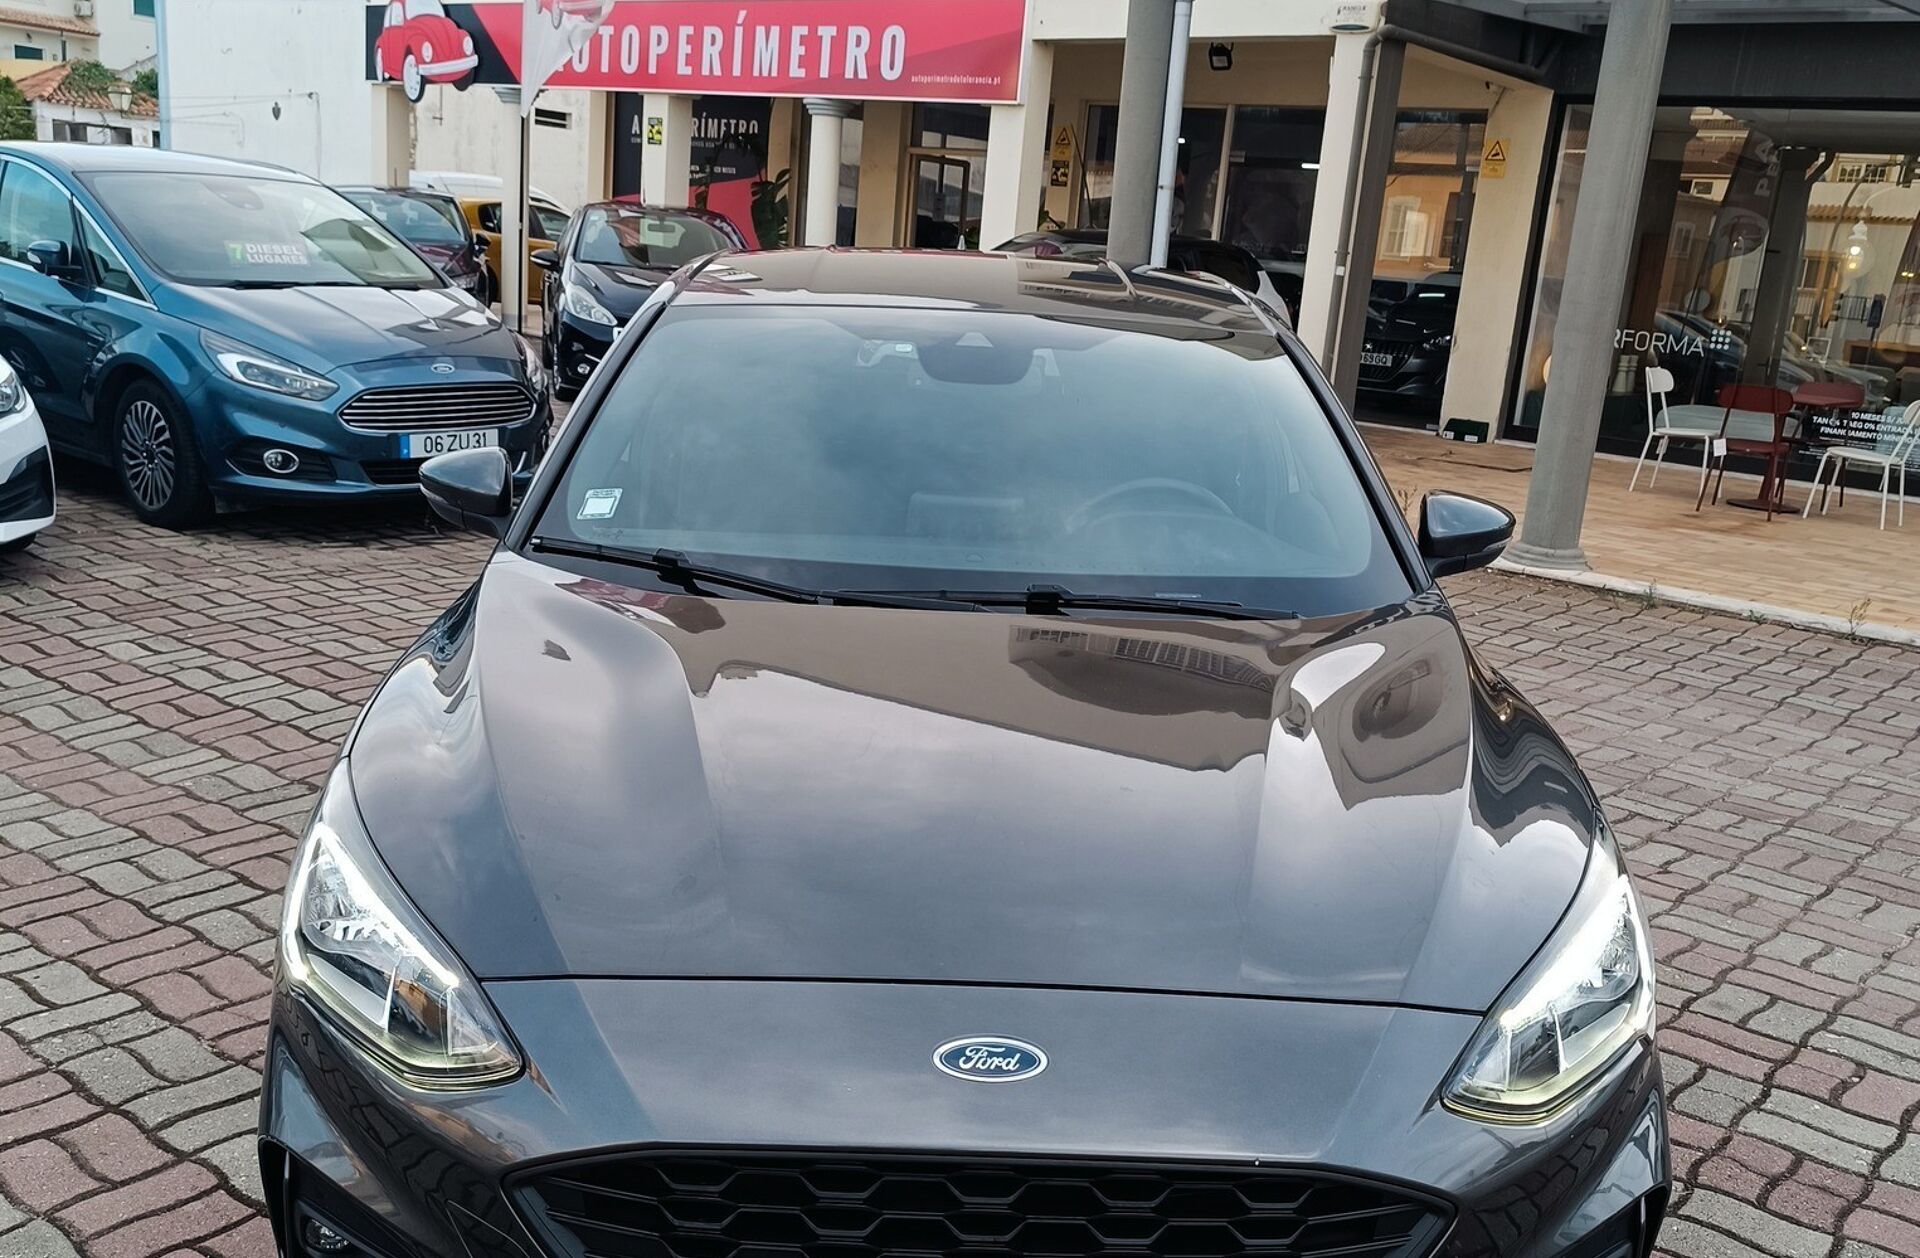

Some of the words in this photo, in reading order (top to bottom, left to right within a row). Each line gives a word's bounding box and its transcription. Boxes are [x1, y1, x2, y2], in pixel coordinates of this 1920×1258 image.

[245, 243, 301, 255] DIESEL
[246, 253, 308, 265] LUGARES
[1812, 415, 1829, 425] TAN
[959, 1045, 1021, 1071] Ford
